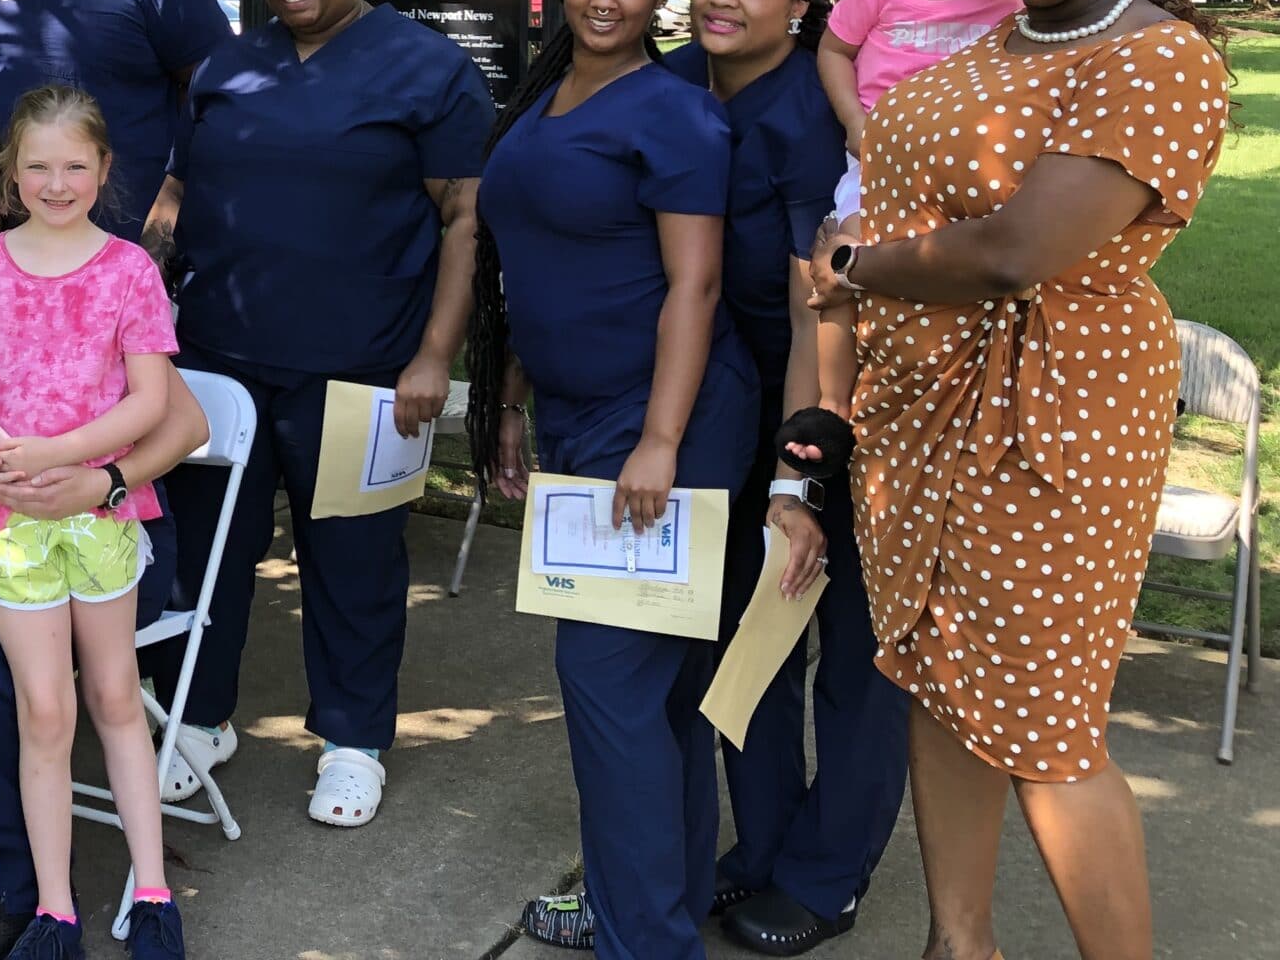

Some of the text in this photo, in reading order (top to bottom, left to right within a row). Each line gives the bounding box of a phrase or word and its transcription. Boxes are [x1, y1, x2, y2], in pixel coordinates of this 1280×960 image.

[417, 9, 463, 24] Newport
[464, 9, 494, 21] News
[545, 575, 576, 590] VHS
